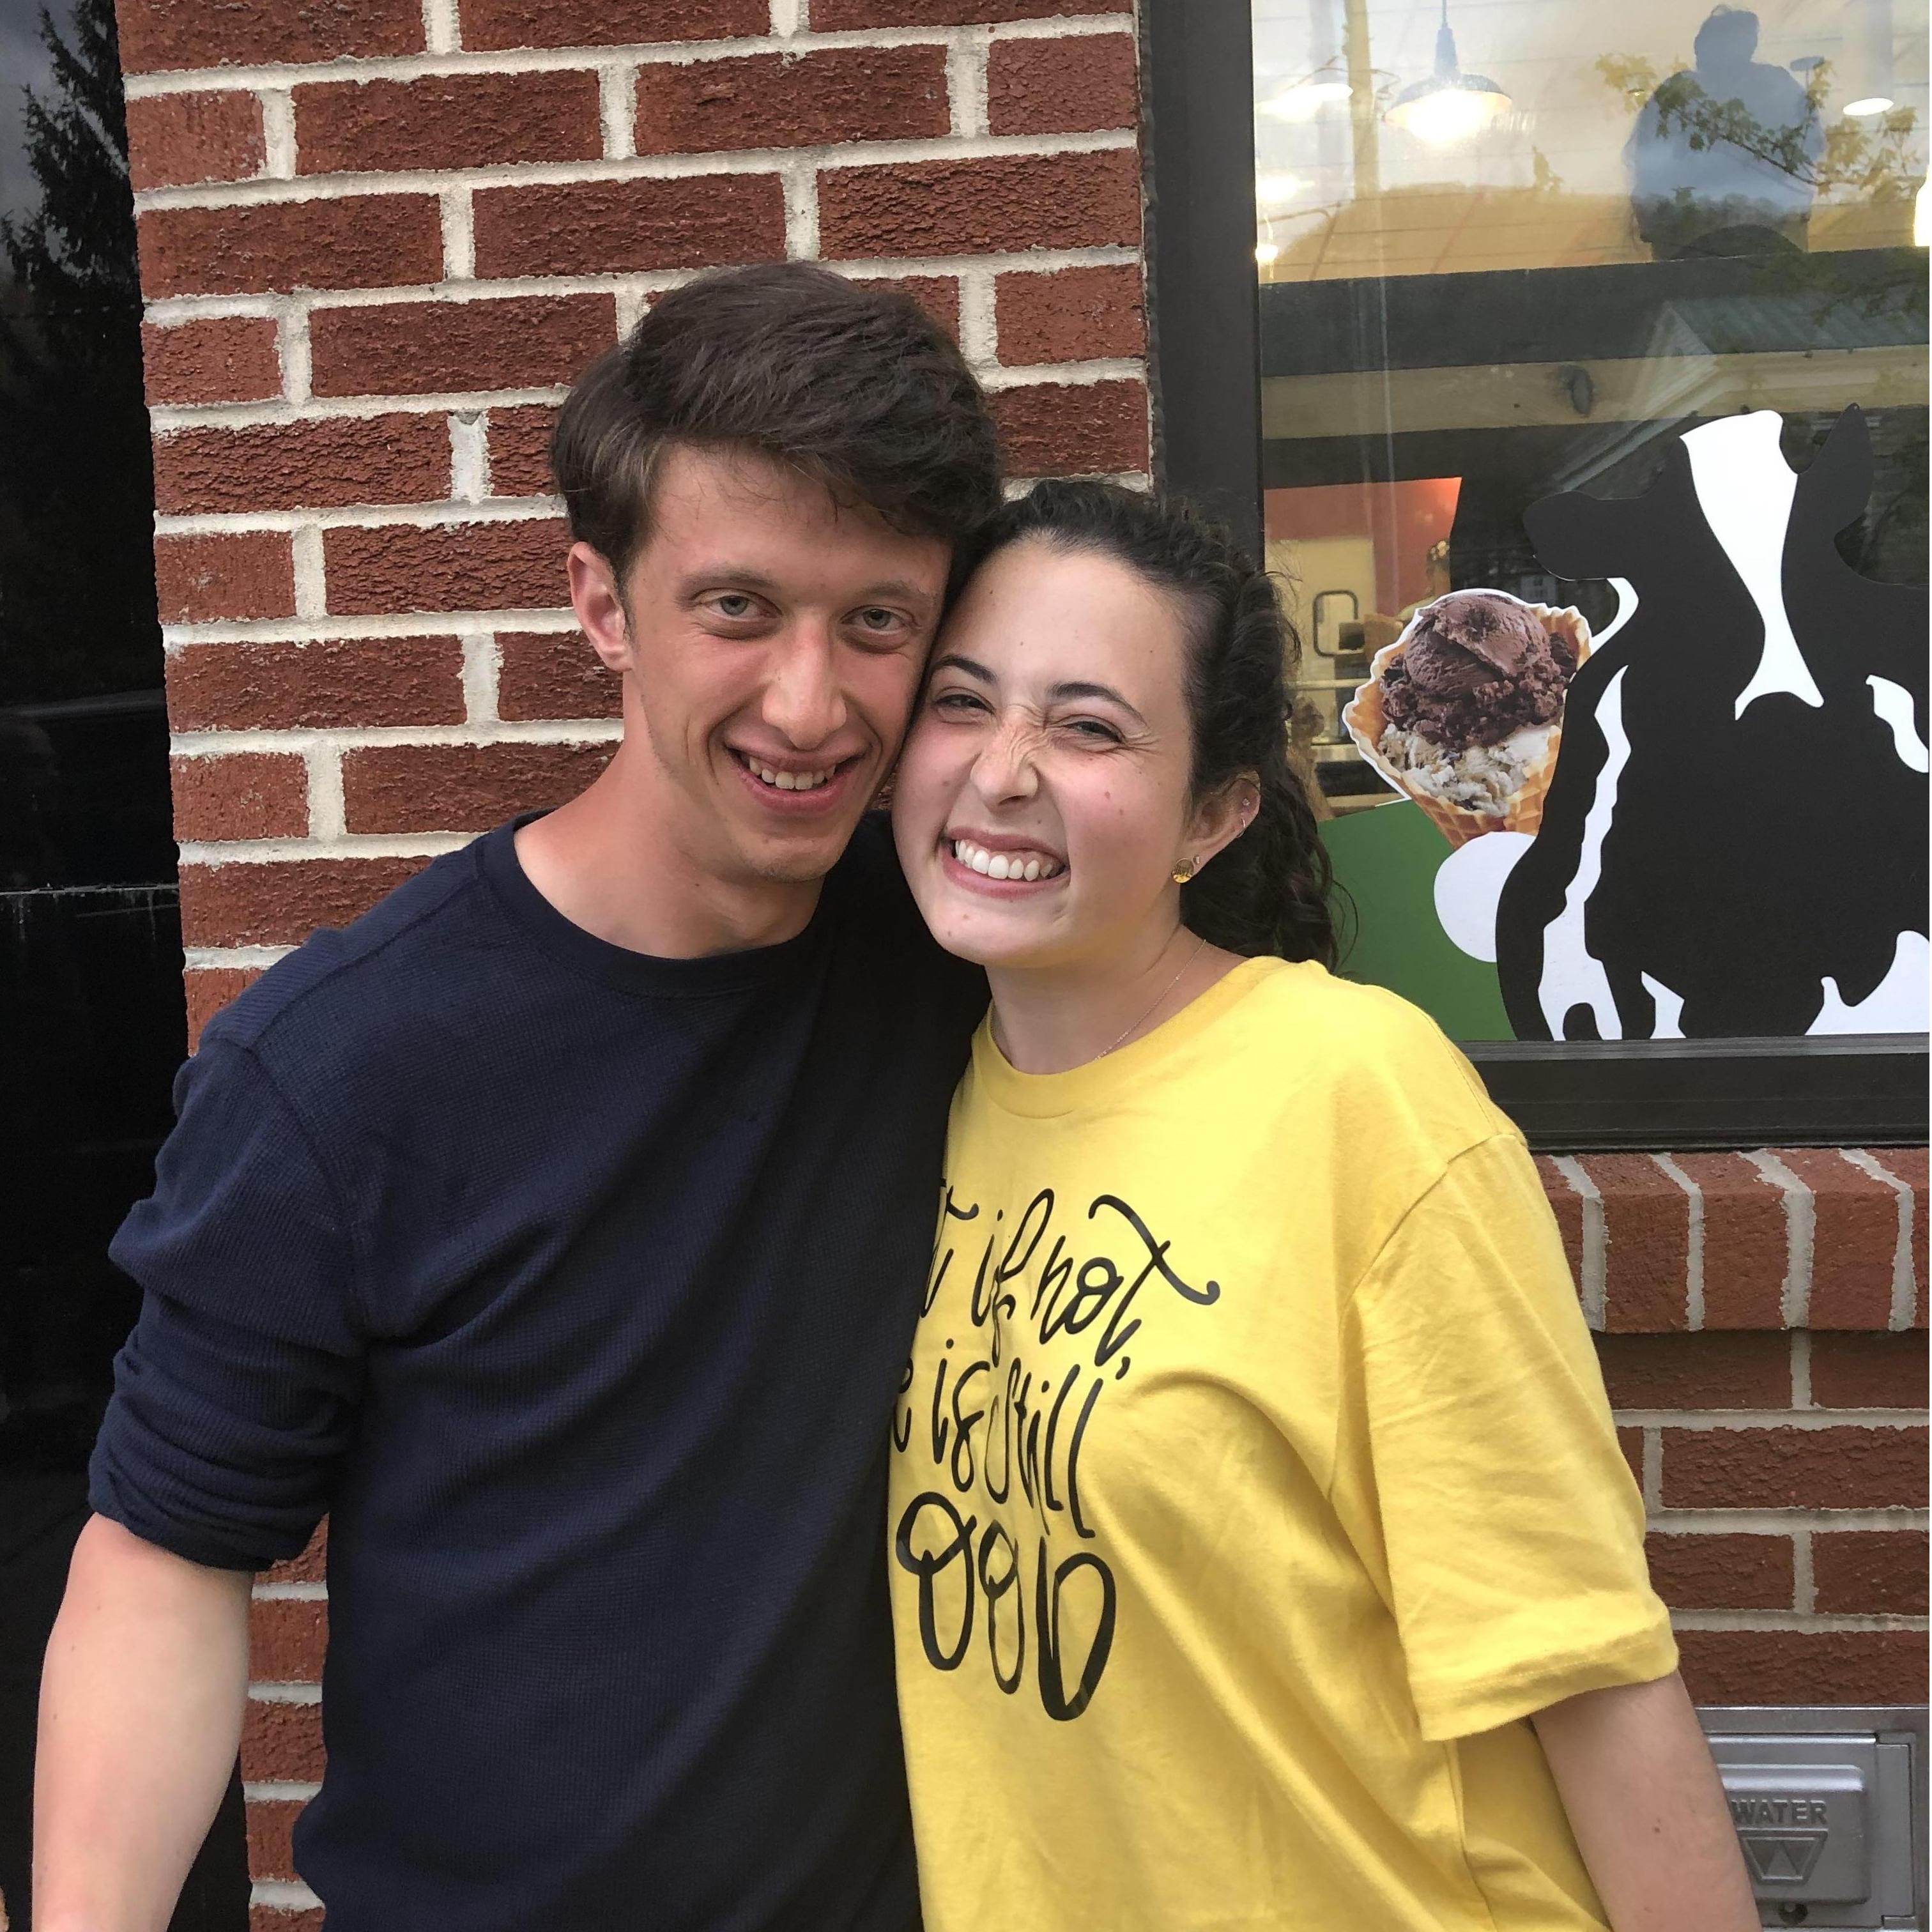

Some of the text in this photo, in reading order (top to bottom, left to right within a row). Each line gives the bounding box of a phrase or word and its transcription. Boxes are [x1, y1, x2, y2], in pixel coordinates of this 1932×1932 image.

[971, 1188, 1055, 1368] if
[1030, 1193, 1221, 1381] not,
[931, 1338, 990, 1492] is
[1731, 1799, 1828, 1824] WATER
